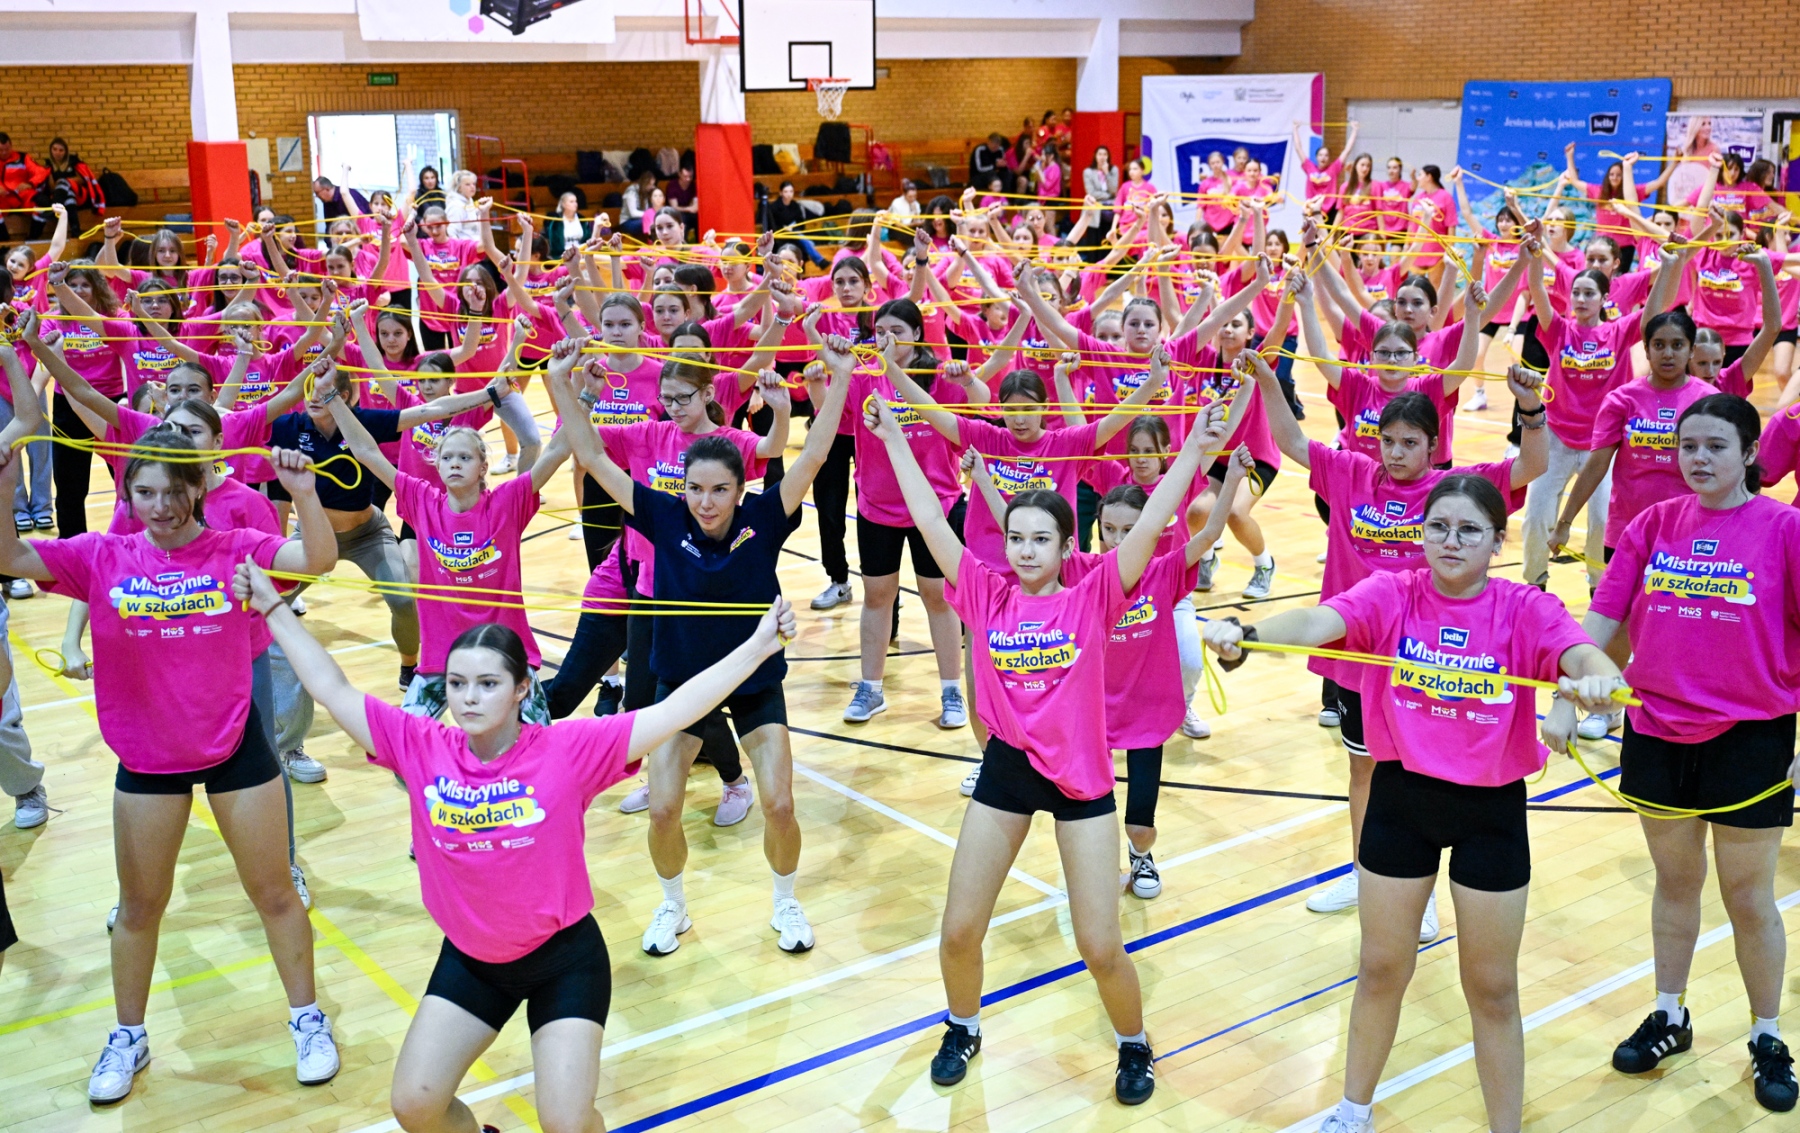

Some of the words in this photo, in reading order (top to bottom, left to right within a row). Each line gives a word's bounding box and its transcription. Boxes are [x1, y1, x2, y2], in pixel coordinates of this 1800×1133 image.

[1594, 118, 1614, 128] bella
[593, 400, 644, 411] Mistrzynie
[1388, 504, 1403, 512] bella
[1366, 527, 1422, 539] szkołach
[1655, 551, 1743, 574] Mistrzynie
[130, 574, 212, 596] Mistrzynie
[1652, 577, 1664, 587] w
[1667, 578, 1738, 595] szkołach
[126, 601, 141, 612] w
[145, 594, 215, 613] szkołach
[989, 628, 1064, 647] Mistrzynie
[1443, 631, 1464, 642] bella
[1006, 649, 1070, 668] szkołach
[1405, 638, 1495, 669] Mistrzynie
[1400, 668, 1414, 682] w
[1418, 674, 1494, 695] szkołach
[450, 803, 524, 825] szkołach
